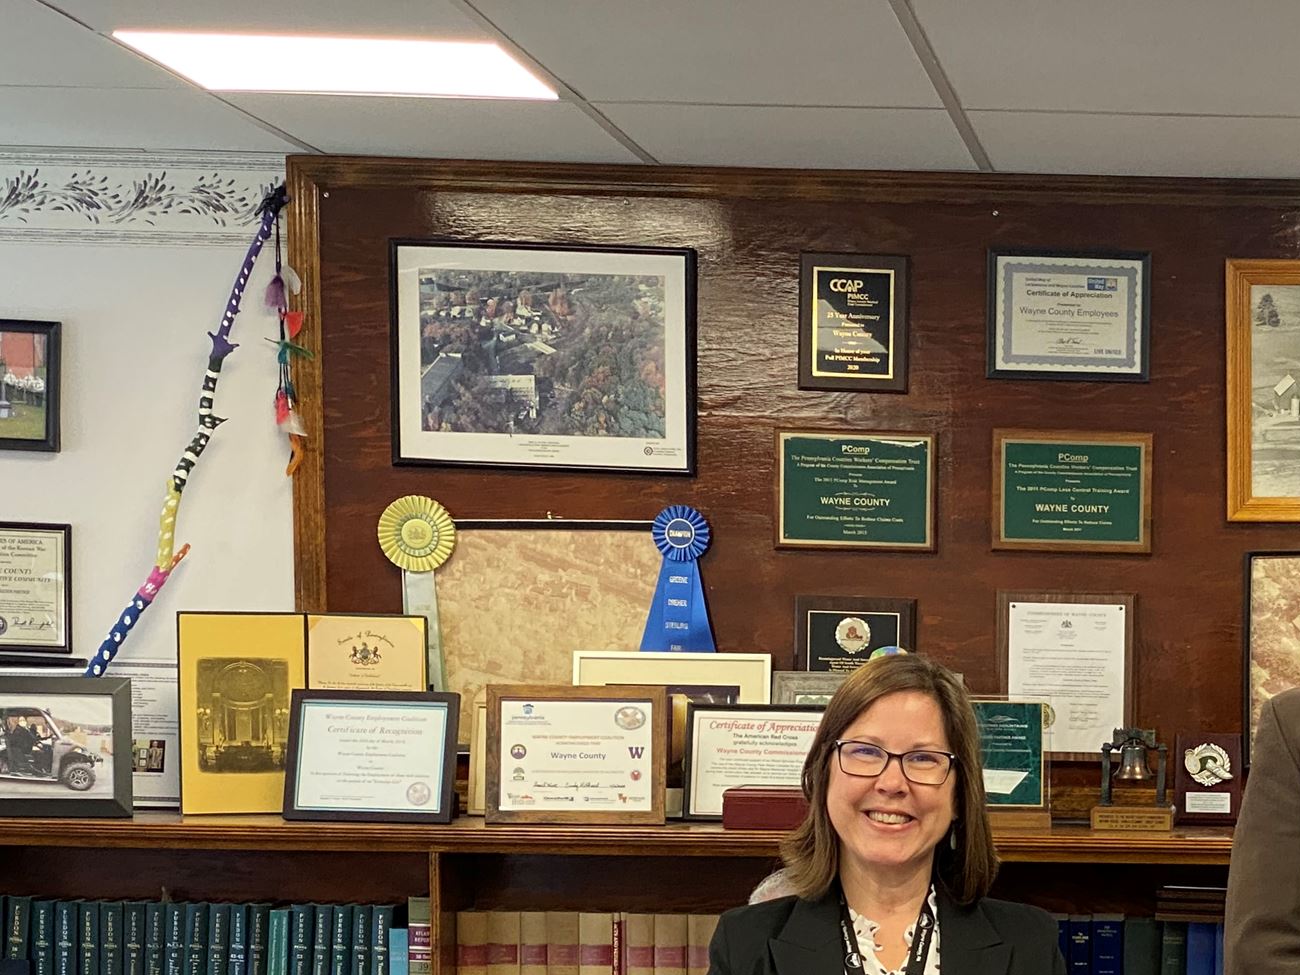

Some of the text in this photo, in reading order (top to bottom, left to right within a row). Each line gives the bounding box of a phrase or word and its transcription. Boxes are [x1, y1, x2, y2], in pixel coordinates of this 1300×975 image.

[829, 278, 864, 292] CCAP
[848, 313, 881, 321] Anniversary
[1019, 307, 1120, 319] Wayne County Employees
[833, 330, 852, 338] Wayne
[841, 445, 870, 454] PComp
[1058, 453, 1089, 462] PComp
[820, 497, 890, 506] WAYNE COUNTY
[1035, 504, 1109, 513] WAYNE COUNTY
[328, 726, 367, 734] Certificate
[379, 727, 423, 736] Recognition
[709, 721, 819, 733] Certificate of Appreciatio
[551, 747, 645, 760] Wayne County W
[740, 748, 762, 756] County
